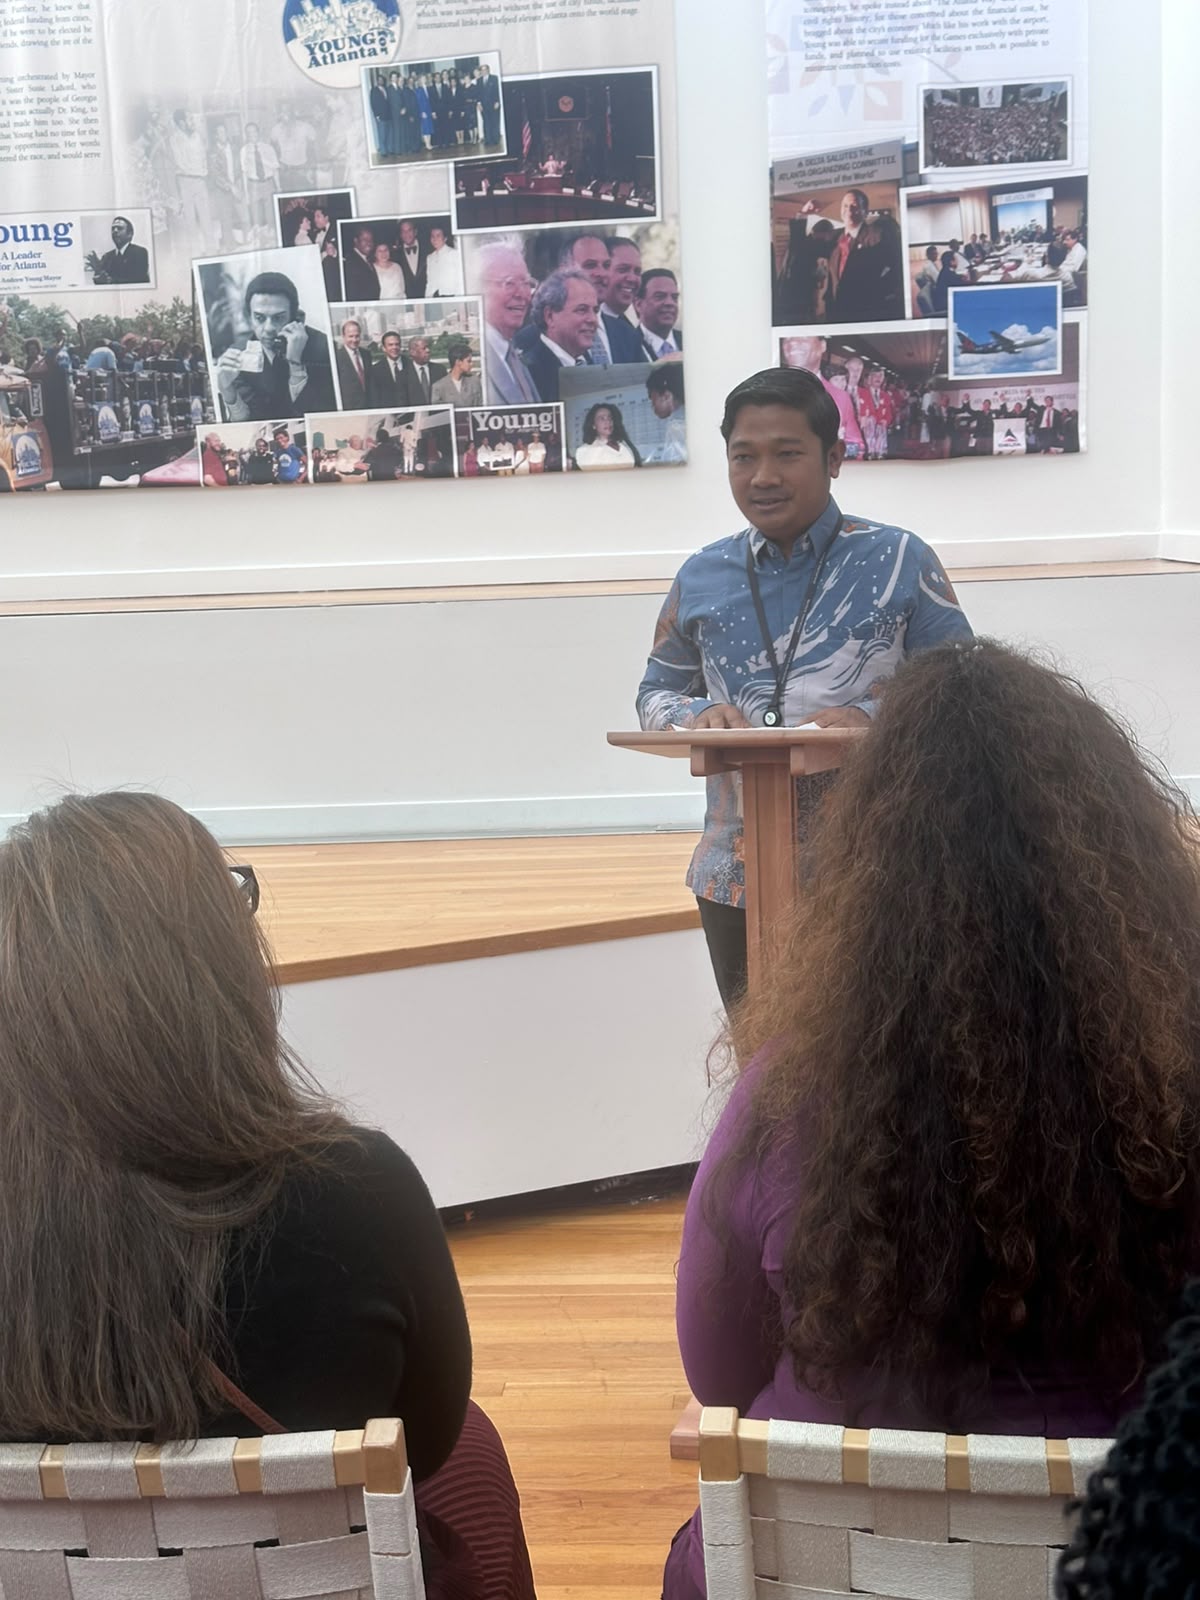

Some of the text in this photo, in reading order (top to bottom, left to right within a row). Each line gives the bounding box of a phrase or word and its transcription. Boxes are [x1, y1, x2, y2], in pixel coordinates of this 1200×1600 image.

[304, 31, 376, 55] YOUNG
[308, 47, 378, 68] Atlanta
[74, 72, 96, 80] Mayor
[2, 251, 43, 261] A Leader
[14, 261, 47, 270] Atlanta
[472, 412, 553, 432] Young
